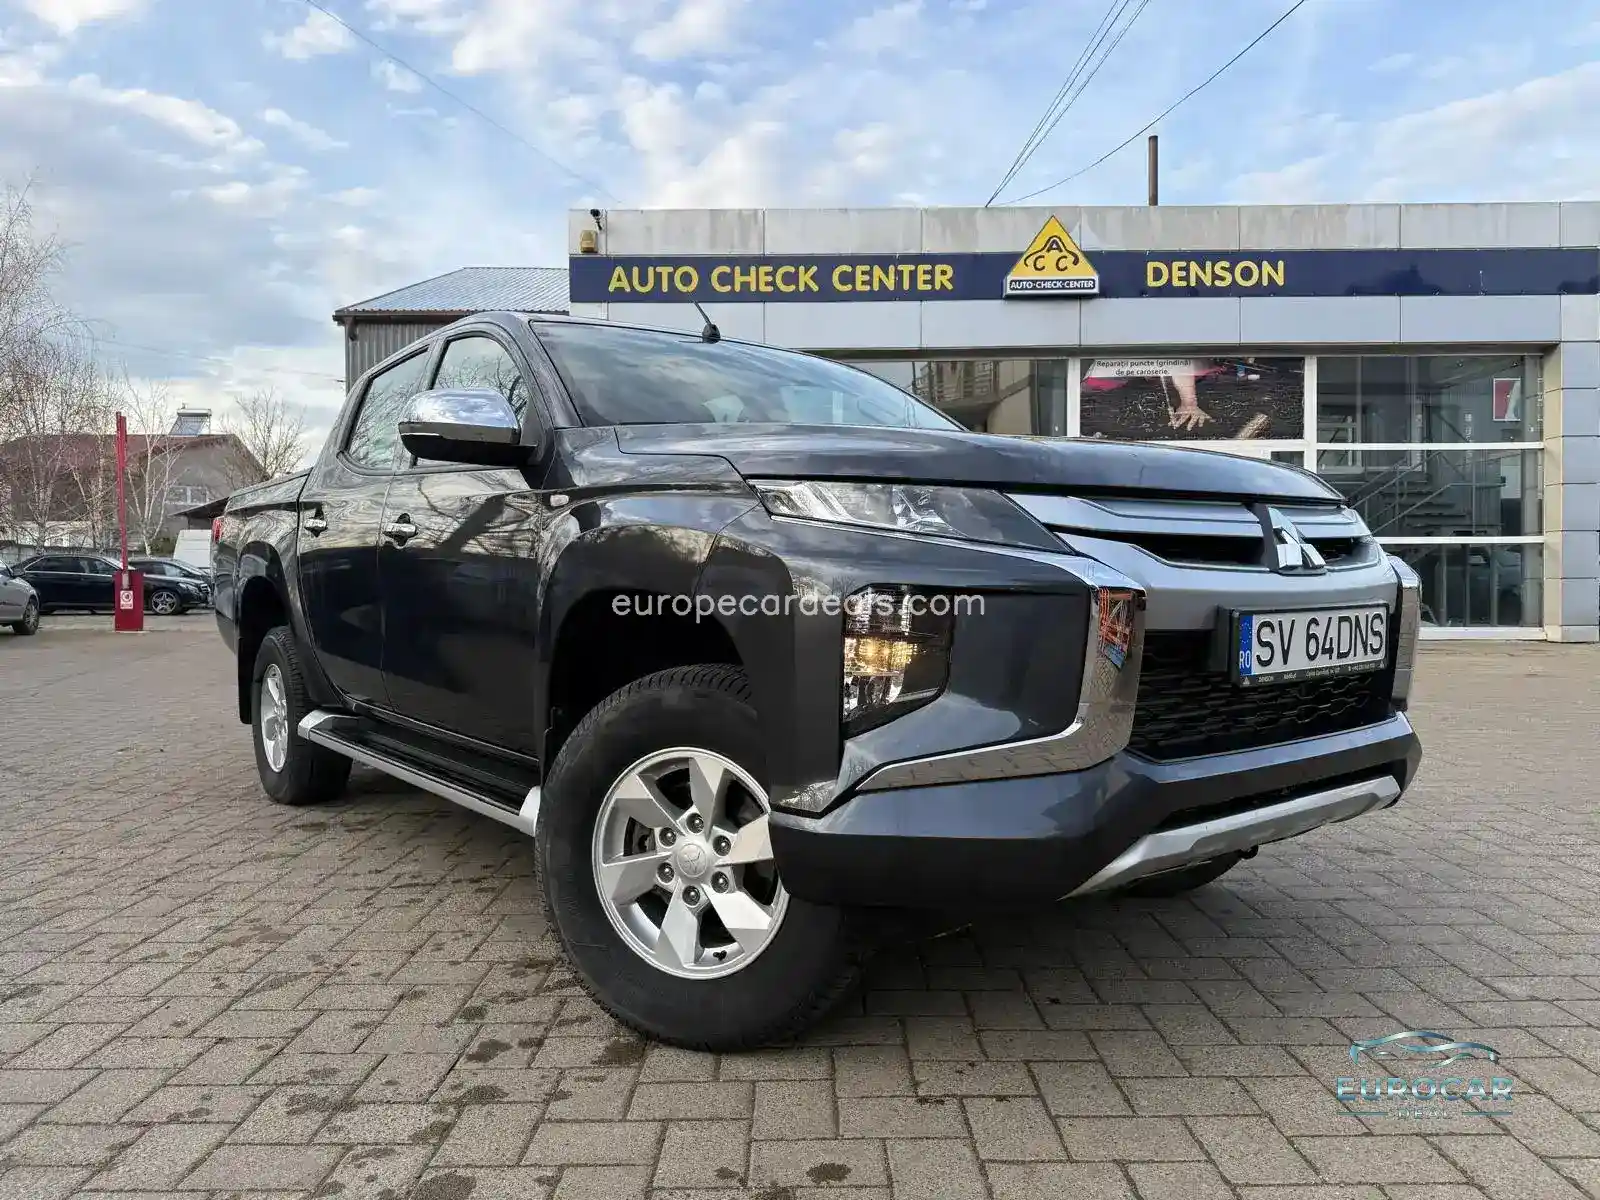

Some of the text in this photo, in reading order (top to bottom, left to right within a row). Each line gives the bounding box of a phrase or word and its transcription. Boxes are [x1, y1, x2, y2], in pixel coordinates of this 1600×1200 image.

[608, 264, 954, 292] AUTO CHECK CENTER
[1147, 260, 1284, 287] DENSON
[1115, 368, 1125, 376] de
[1256, 612, 1384, 667] SV 64DNS
[1239, 650, 1251, 669] RO
